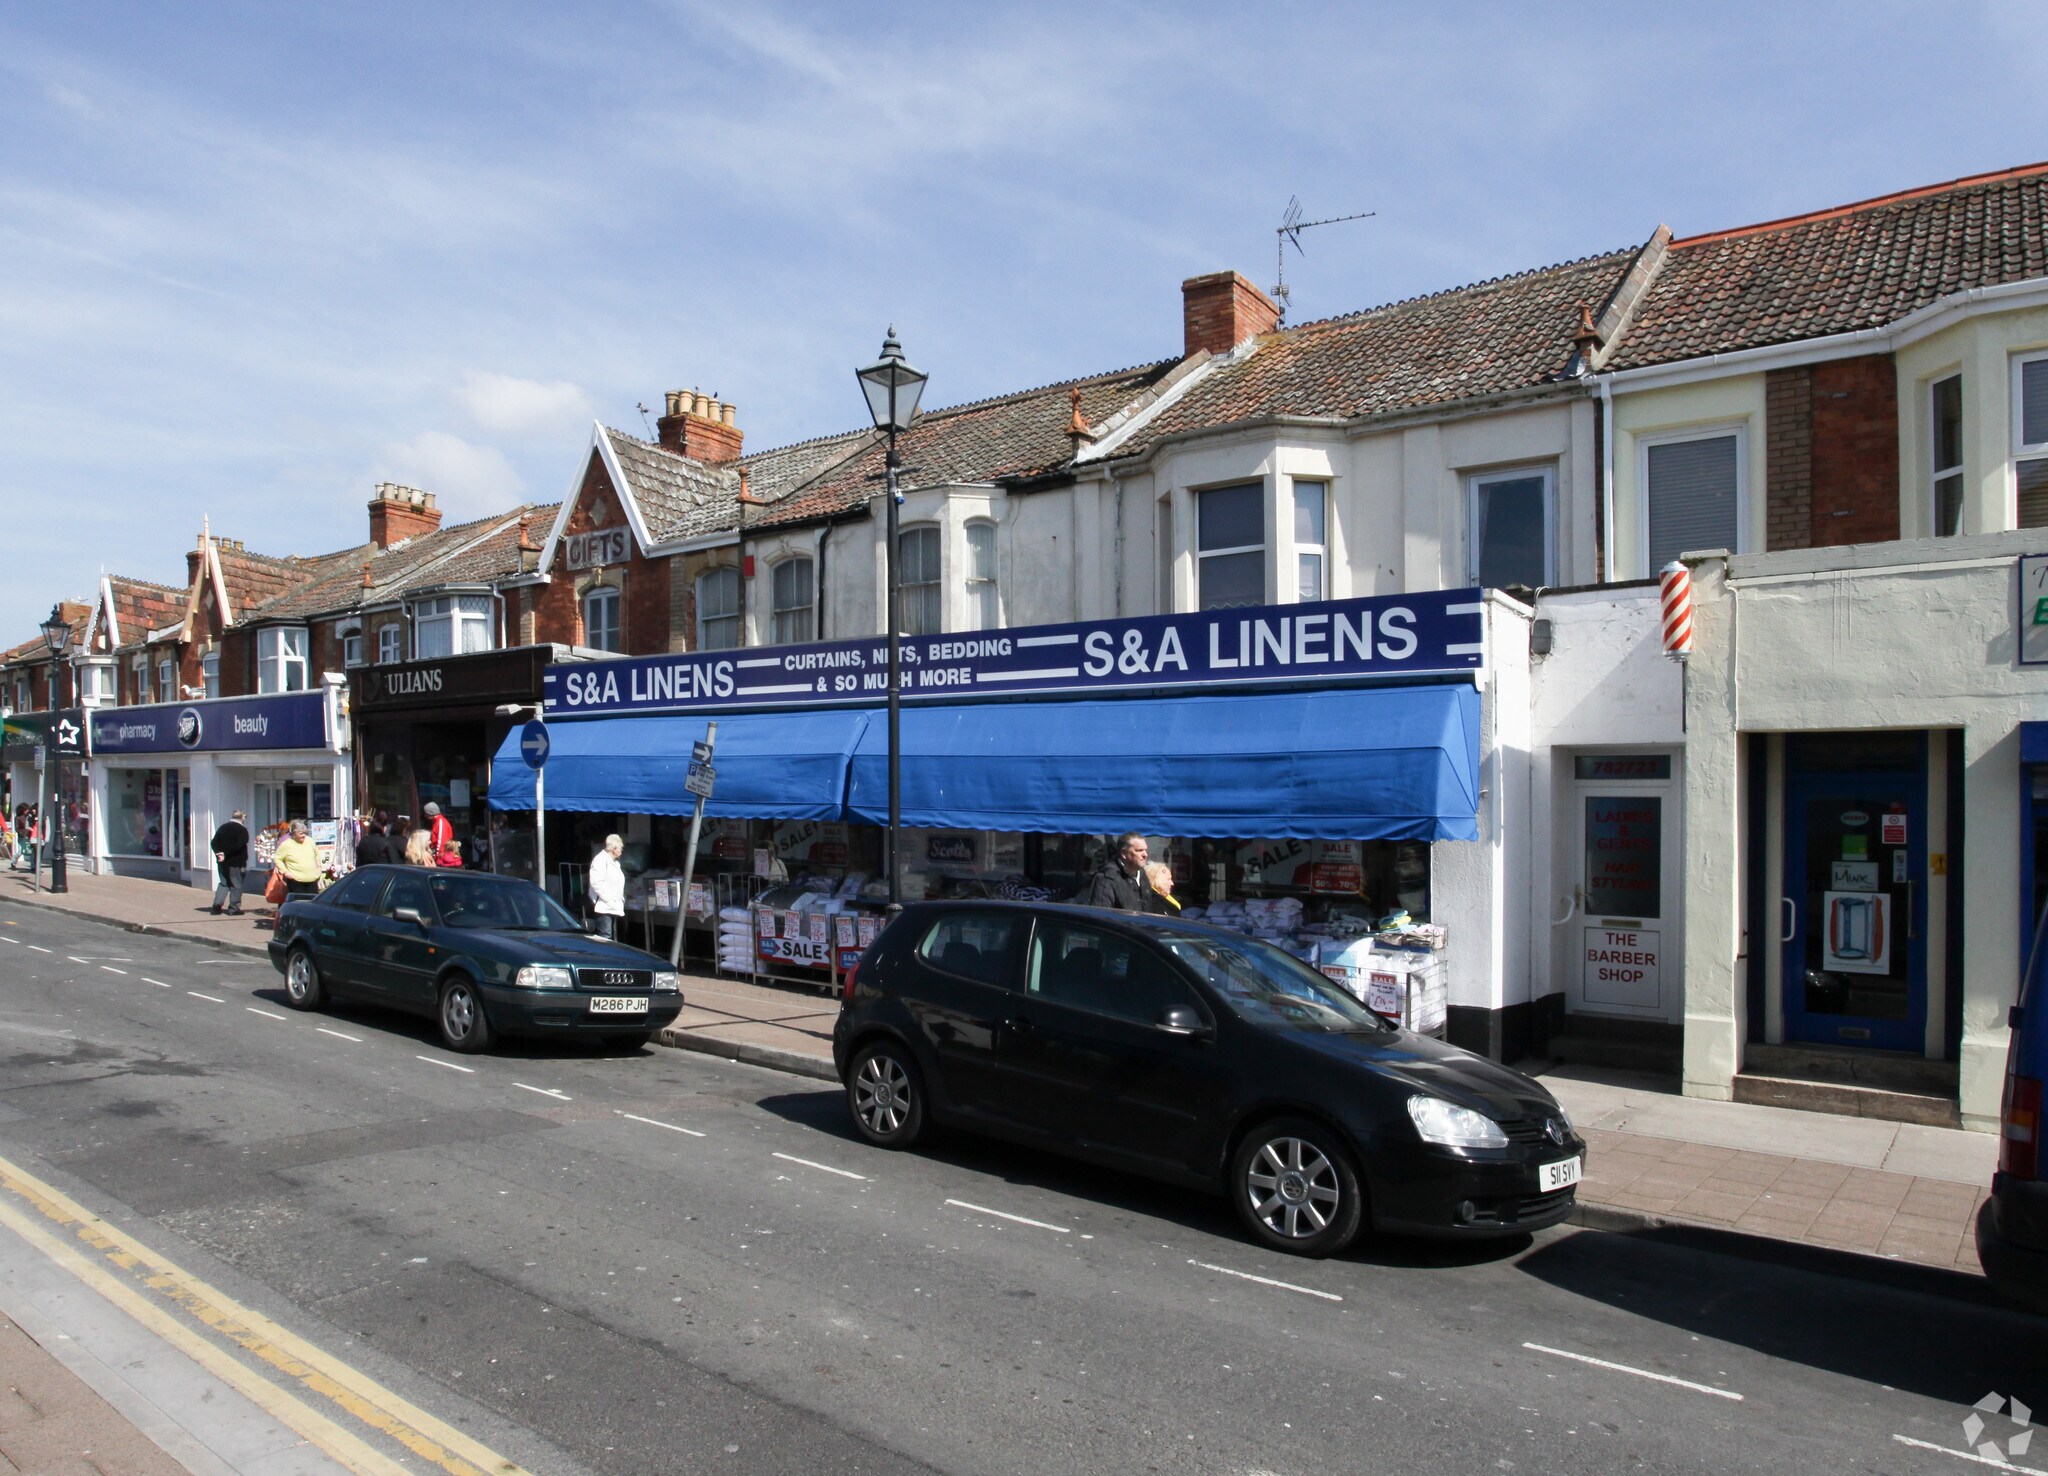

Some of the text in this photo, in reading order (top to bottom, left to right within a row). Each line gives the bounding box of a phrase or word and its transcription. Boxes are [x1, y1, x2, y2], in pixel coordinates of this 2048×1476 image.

[569, 531, 625, 565] GIFTS
[1082, 606, 1418, 678] S&A LINENS
[784, 649, 866, 671] CURTAINS,
[928, 637, 1012, 661] BEDDING
[566, 660, 734, 706] S&A LINENS
[816, 667, 972, 693] & SO MUH MORE
[119, 722, 156, 742] pharmacy
[234, 713, 268, 737] beauty
[1593, 761, 1658, 774] 782723
[780, 823, 813, 851] SALE
[1596, 838, 1652, 850] GENTS
[1247, 837, 1303, 874] SALE
[1323, 843, 1351, 853] SALE
[1606, 932, 1638, 947] THE
[782, 942, 823, 960] SALE
[1587, 949, 1656, 967] BARBER
[1324, 968, 1345, 977] SALE
[1372, 976, 1395, 985] SALE
[1598, 967, 1644, 983] SHOP
[592, 999, 648, 1011] M286 PJH
